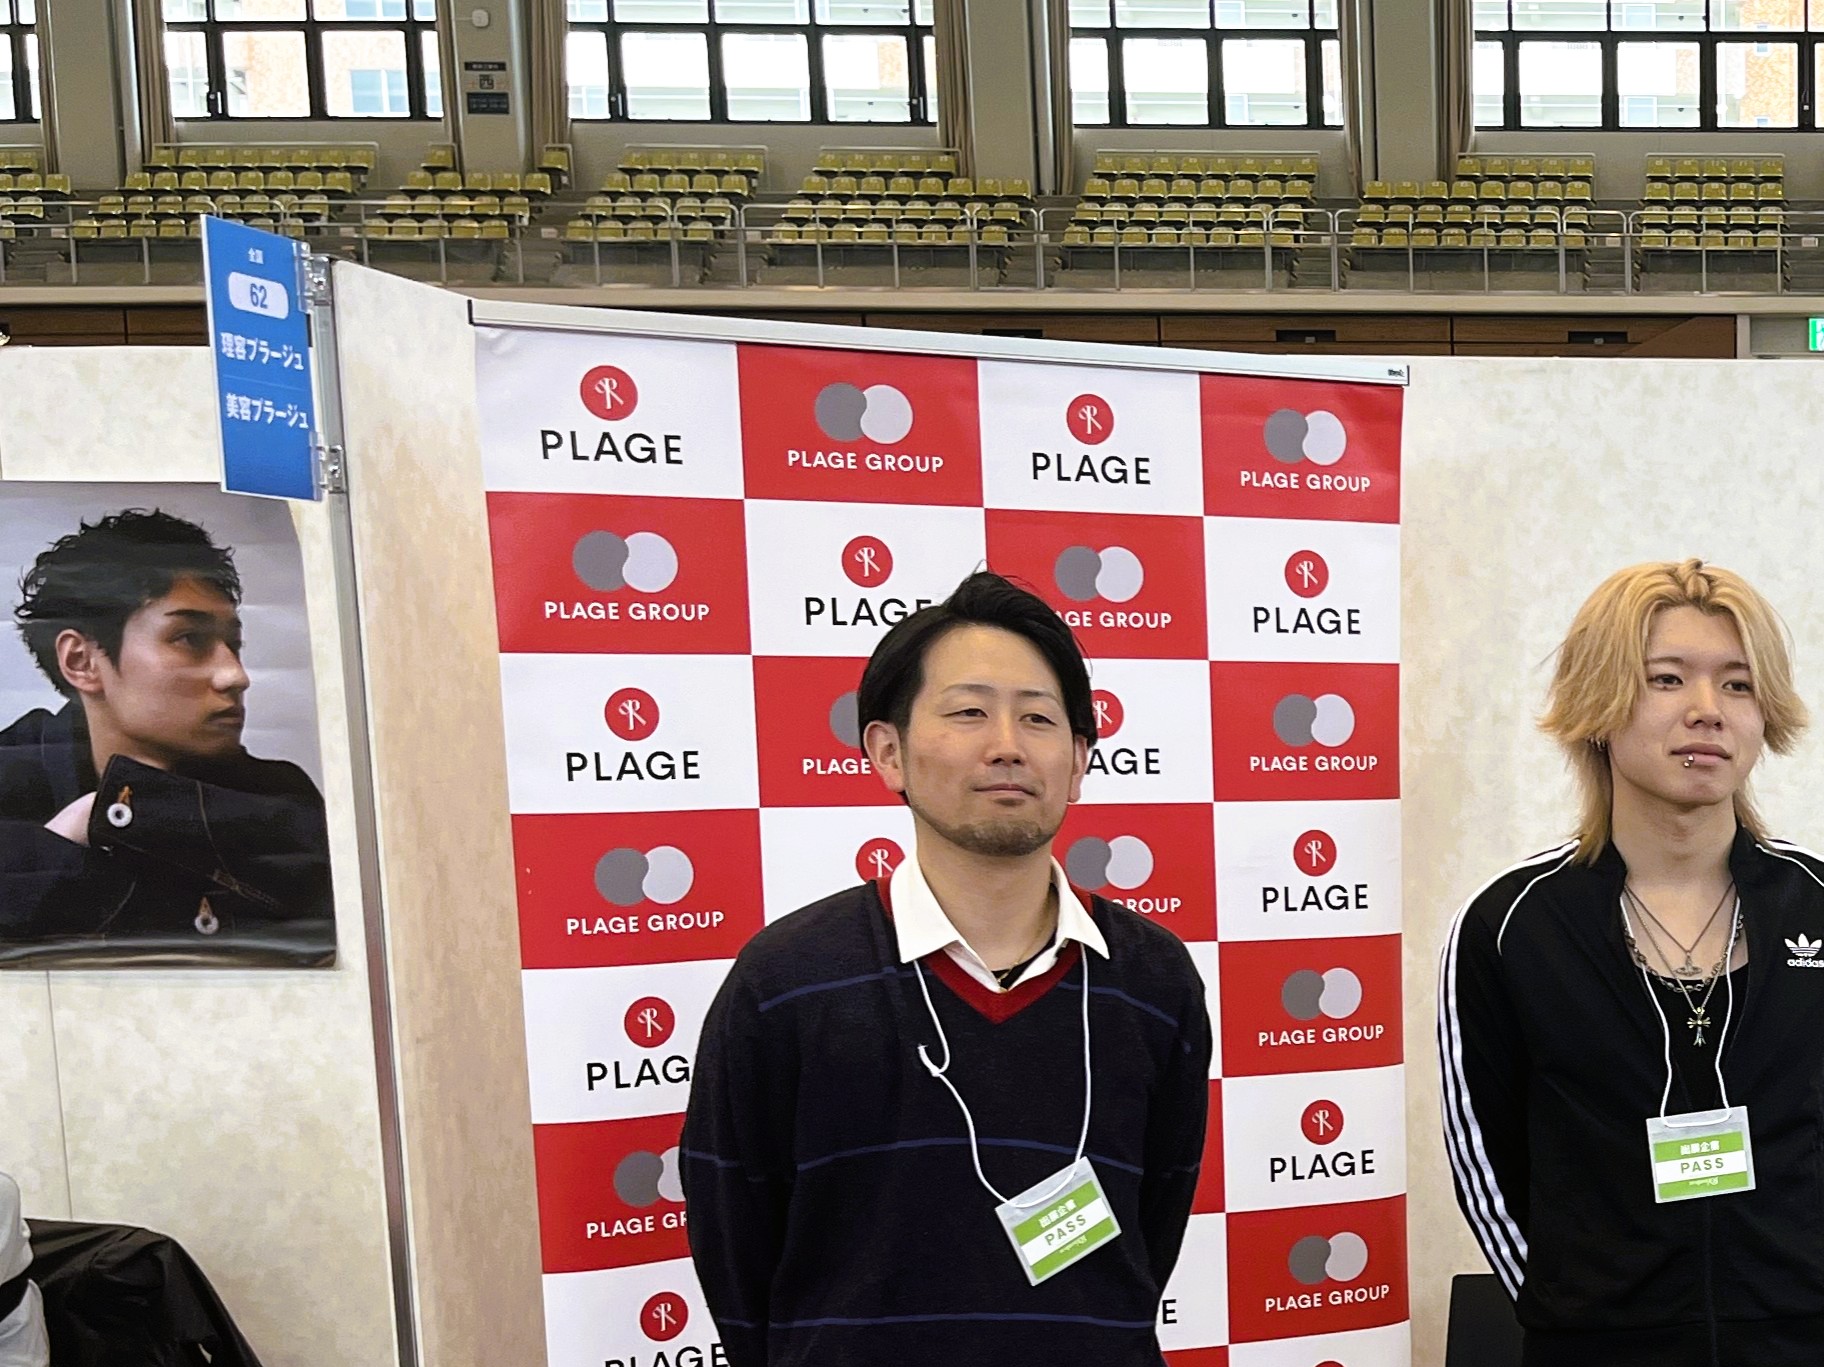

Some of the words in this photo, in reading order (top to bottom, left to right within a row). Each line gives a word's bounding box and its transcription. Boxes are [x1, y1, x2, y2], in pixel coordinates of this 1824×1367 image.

[250, 283, 268, 309] 62
[220, 332, 304, 371] 理容プラージュ
[226, 393, 309, 429] 美容プラージュ
[540, 429, 684, 465] PLAGE
[787, 450, 857, 470] PLAGE
[865, 453, 944, 473] GROUP
[1031, 452, 1151, 485] PLAGE
[1240, 471, 1300, 489] PLAGE
[1306, 473, 1371, 492] GROUP
[544, 601, 620, 620] PLAGE
[628, 602, 710, 622] GROUP
[1099, 611, 1172, 629] GROUP
[1253, 607, 1361, 635] PLAGE
[566, 750, 700, 782] PLAGE
[803, 758, 871, 775] PLAGE
[1086, 748, 1161, 775] AGE
[1250, 755, 1308, 772] PLAGE
[1314, 755, 1378, 771] GROUP
[1112, 897, 1182, 915] ROUP
[1262, 884, 1369, 913] PLAGE
[566, 916, 639, 935] PLAGE
[647, 911, 725, 933] GROUP
[1258, 1029, 1315, 1047] PLAGE
[1322, 1024, 1384, 1043] GROUP
[586, 1055, 690, 1092] PLAG
[1270, 1149, 1375, 1183] PLAGE
[1681, 1158, 1724, 1173] PASS
[586, 1216, 655, 1239] PLAGE
[1045, 1214, 1087, 1245] PASS
[1265, 1293, 1322, 1313] PLAGE
[1328, 1285, 1390, 1305] GROUP
